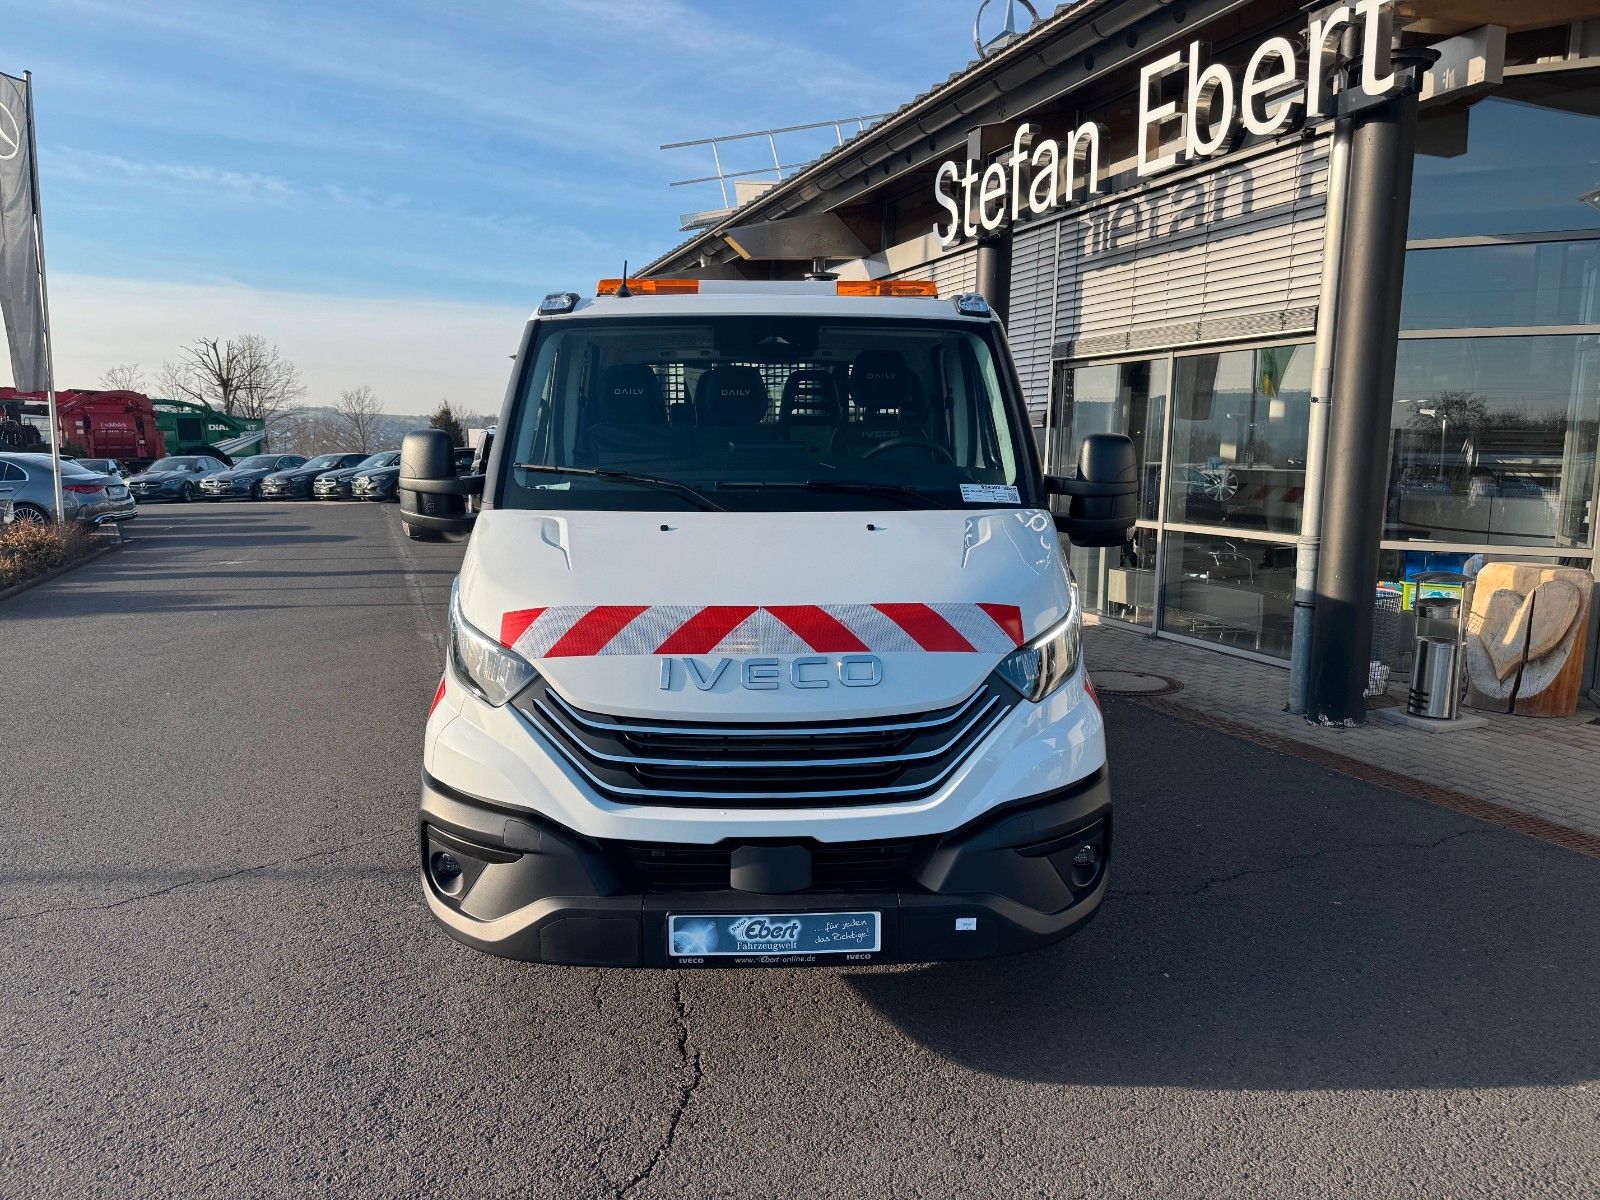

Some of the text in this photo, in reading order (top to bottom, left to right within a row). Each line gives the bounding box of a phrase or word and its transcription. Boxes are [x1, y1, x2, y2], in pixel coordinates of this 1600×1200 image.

[933, 0, 1395, 248] Stefan Ebert
[866, 372, 896, 380] DAILY
[659, 654, 882, 692] IVECO
[744, 919, 799, 940] Ebert
[841, 918, 868, 930] jeden
[814, 935, 831, 944] das
[736, 941, 798, 951] Fahrzeugwelt
